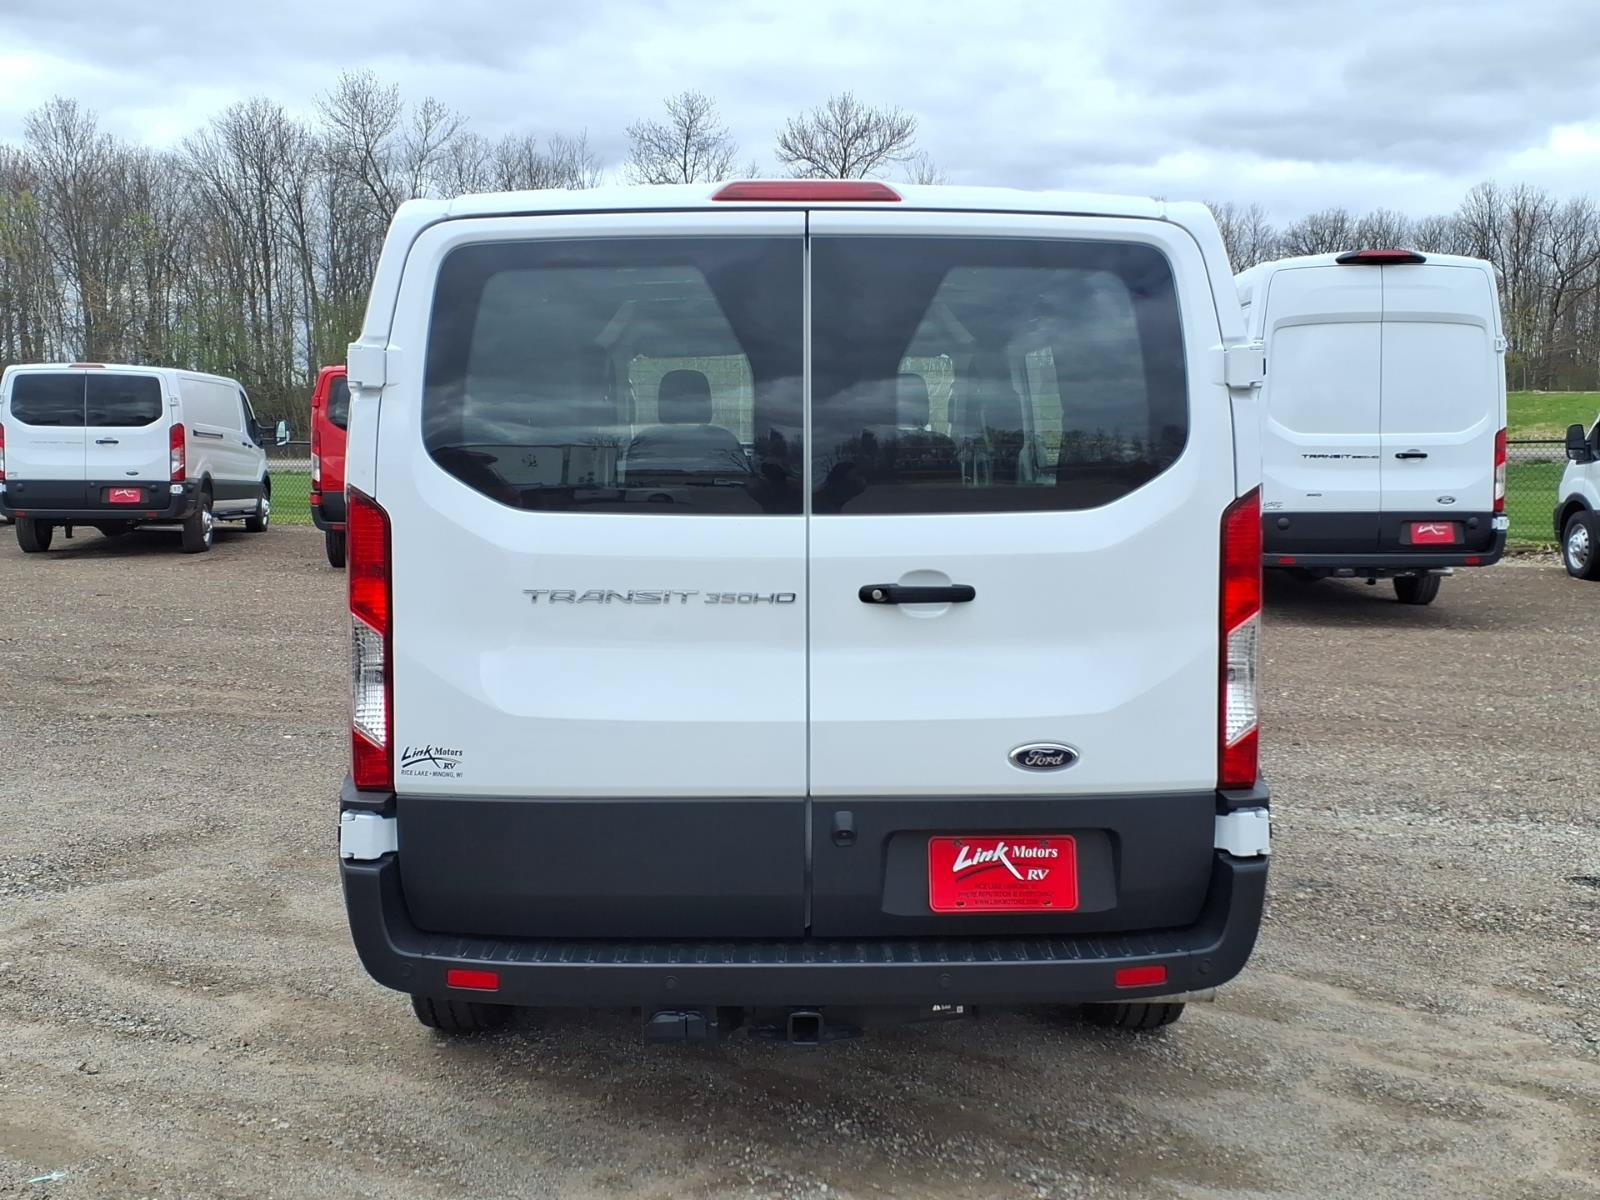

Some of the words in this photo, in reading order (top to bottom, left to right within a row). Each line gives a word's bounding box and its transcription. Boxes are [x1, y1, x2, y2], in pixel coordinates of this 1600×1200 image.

[522, 589, 699, 605] TRANSIT
[703, 591, 797, 605] 350HD
[401, 744, 439, 767] Link
[434, 747, 463, 756] Motors
[1025, 749, 1064, 766] Ford
[952, 841, 1023, 880] Link
[1012, 845, 1058, 858] Motors
[1027, 868, 1049, 881] RV
